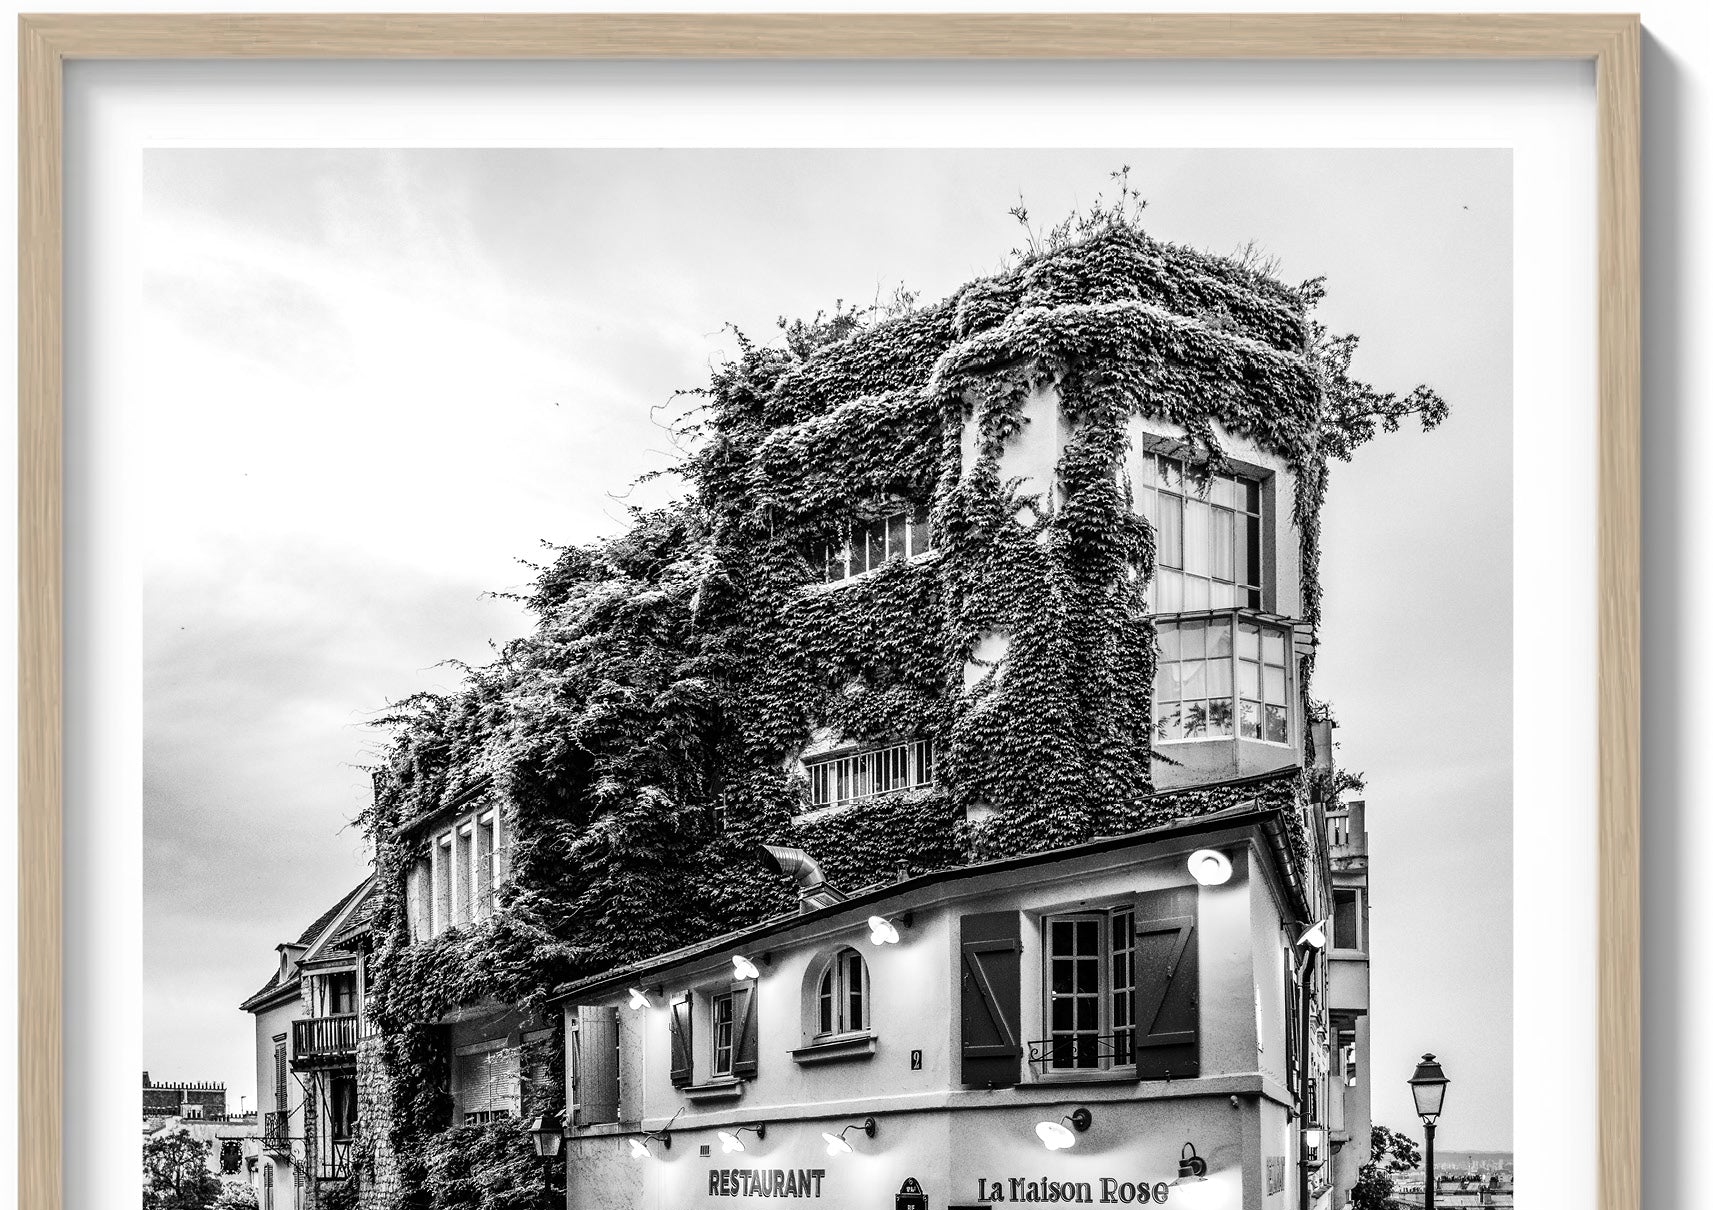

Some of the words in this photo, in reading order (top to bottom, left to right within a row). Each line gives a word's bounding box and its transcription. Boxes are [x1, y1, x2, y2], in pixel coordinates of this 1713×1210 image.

[708, 1168, 826, 1198] RESTAURANT
[977, 1177, 1005, 1203] La
[1008, 1176, 1094, 1204] Maison
[1099, 1177, 1170, 1205] Rose
